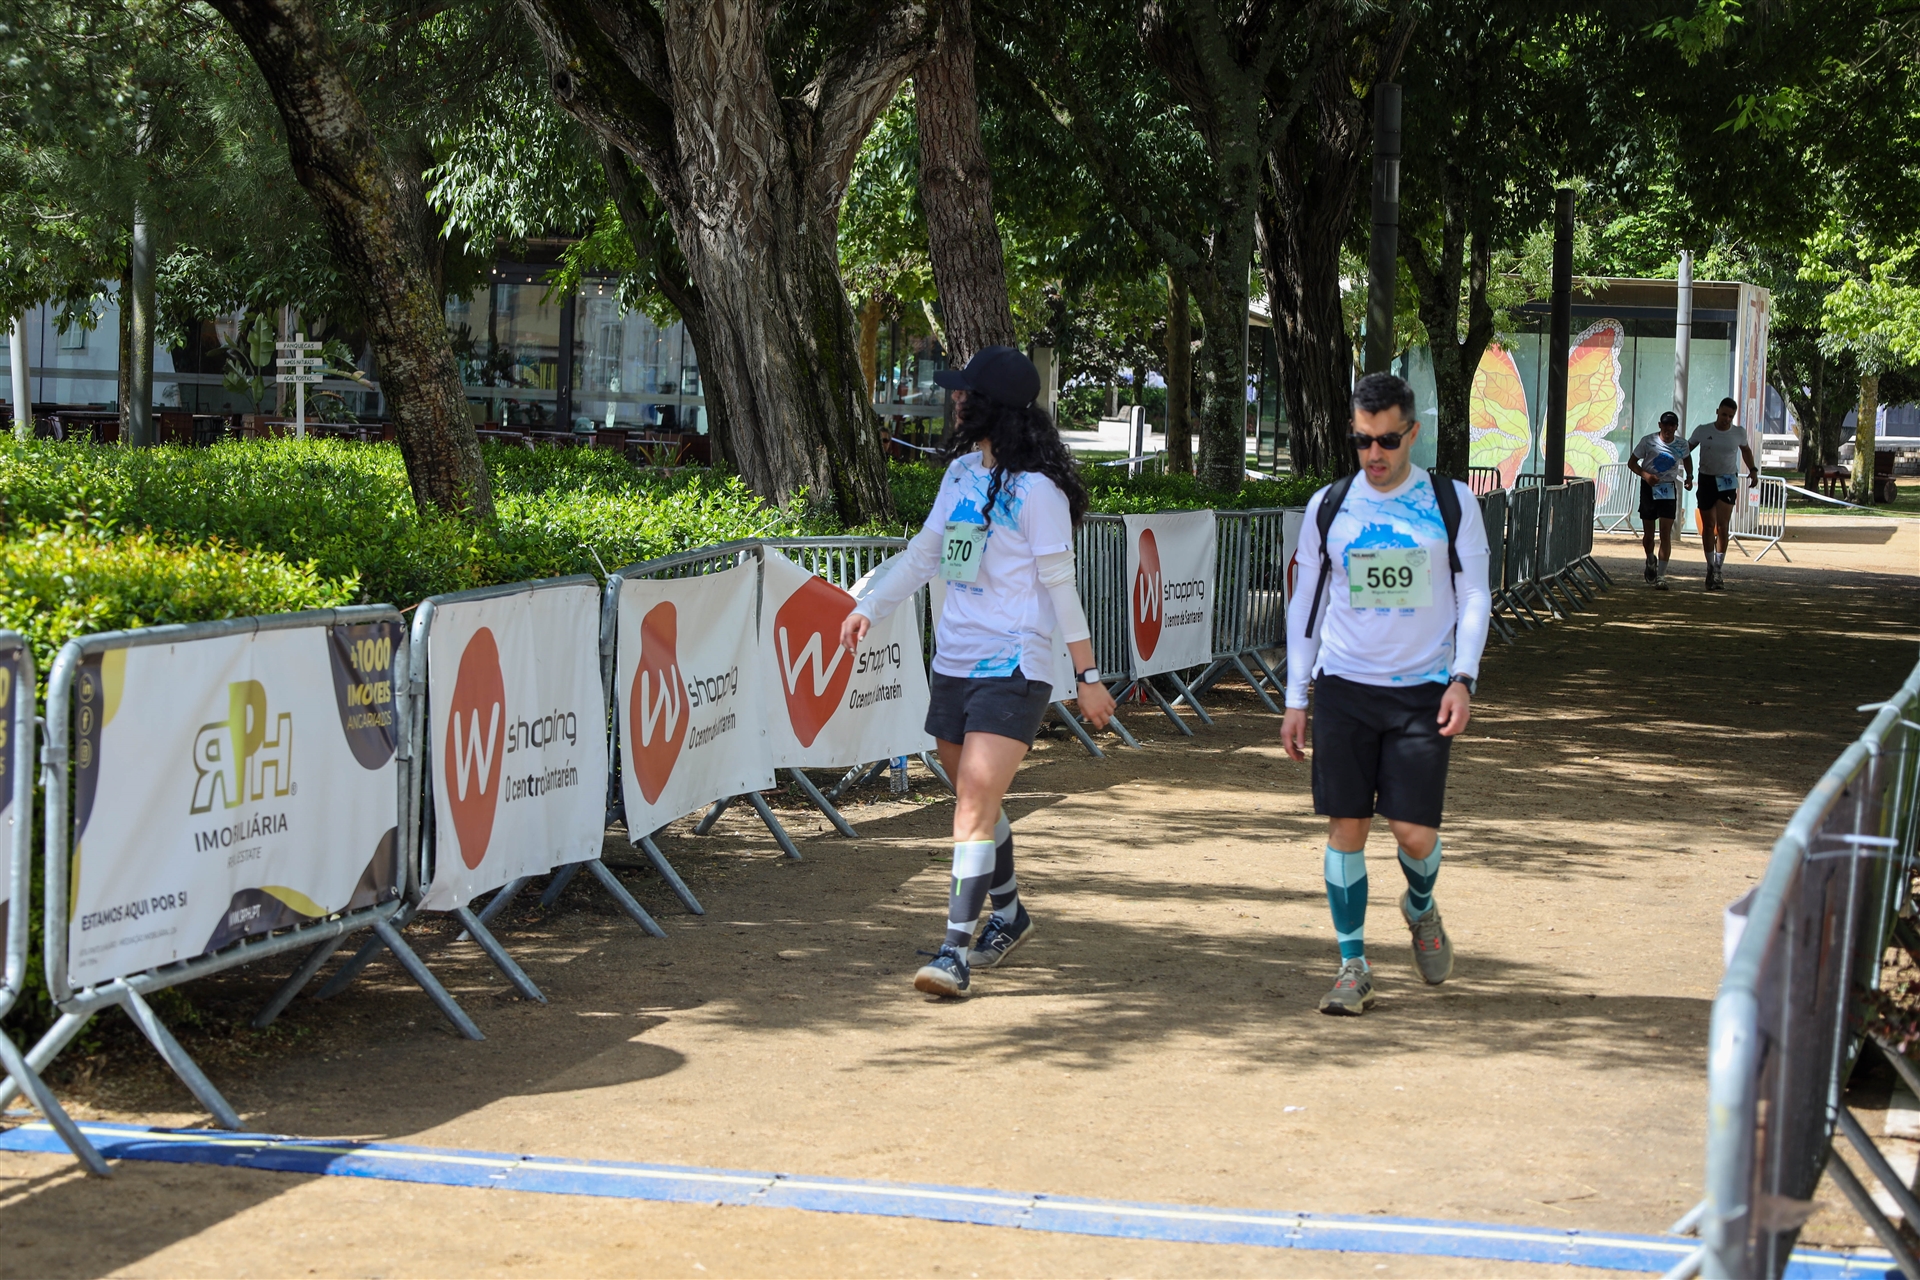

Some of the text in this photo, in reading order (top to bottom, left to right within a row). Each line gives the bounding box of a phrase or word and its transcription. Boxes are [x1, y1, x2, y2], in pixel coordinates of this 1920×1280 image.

[946, 539, 972, 562] 570
[1367, 565, 1413, 588] 569
[1164, 577, 1205, 603] shopping
[512, 773, 544, 801] centro
[81, 890, 188, 931] ESTAMOS AQUI POR SI
